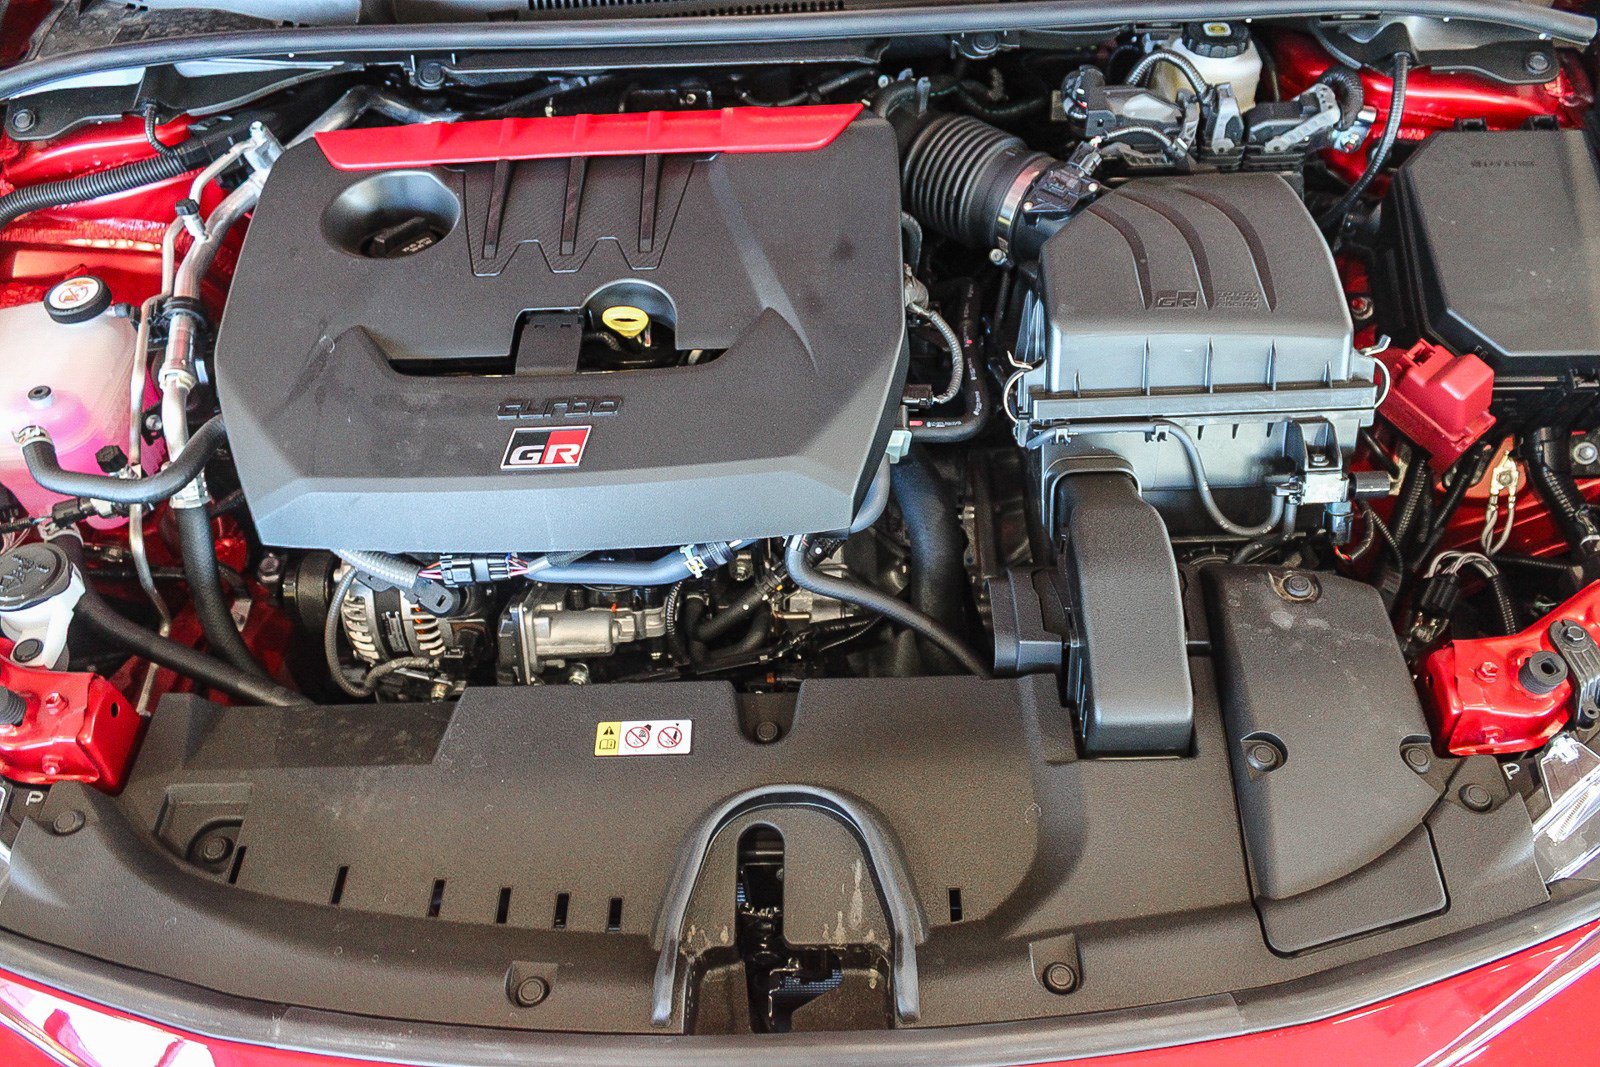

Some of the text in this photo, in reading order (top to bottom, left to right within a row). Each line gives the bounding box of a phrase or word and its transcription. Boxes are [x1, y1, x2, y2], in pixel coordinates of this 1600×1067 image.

[509, 444, 581, 464] GR
[1502, 763, 1520, 780] P
[26, 791, 44, 806] P
